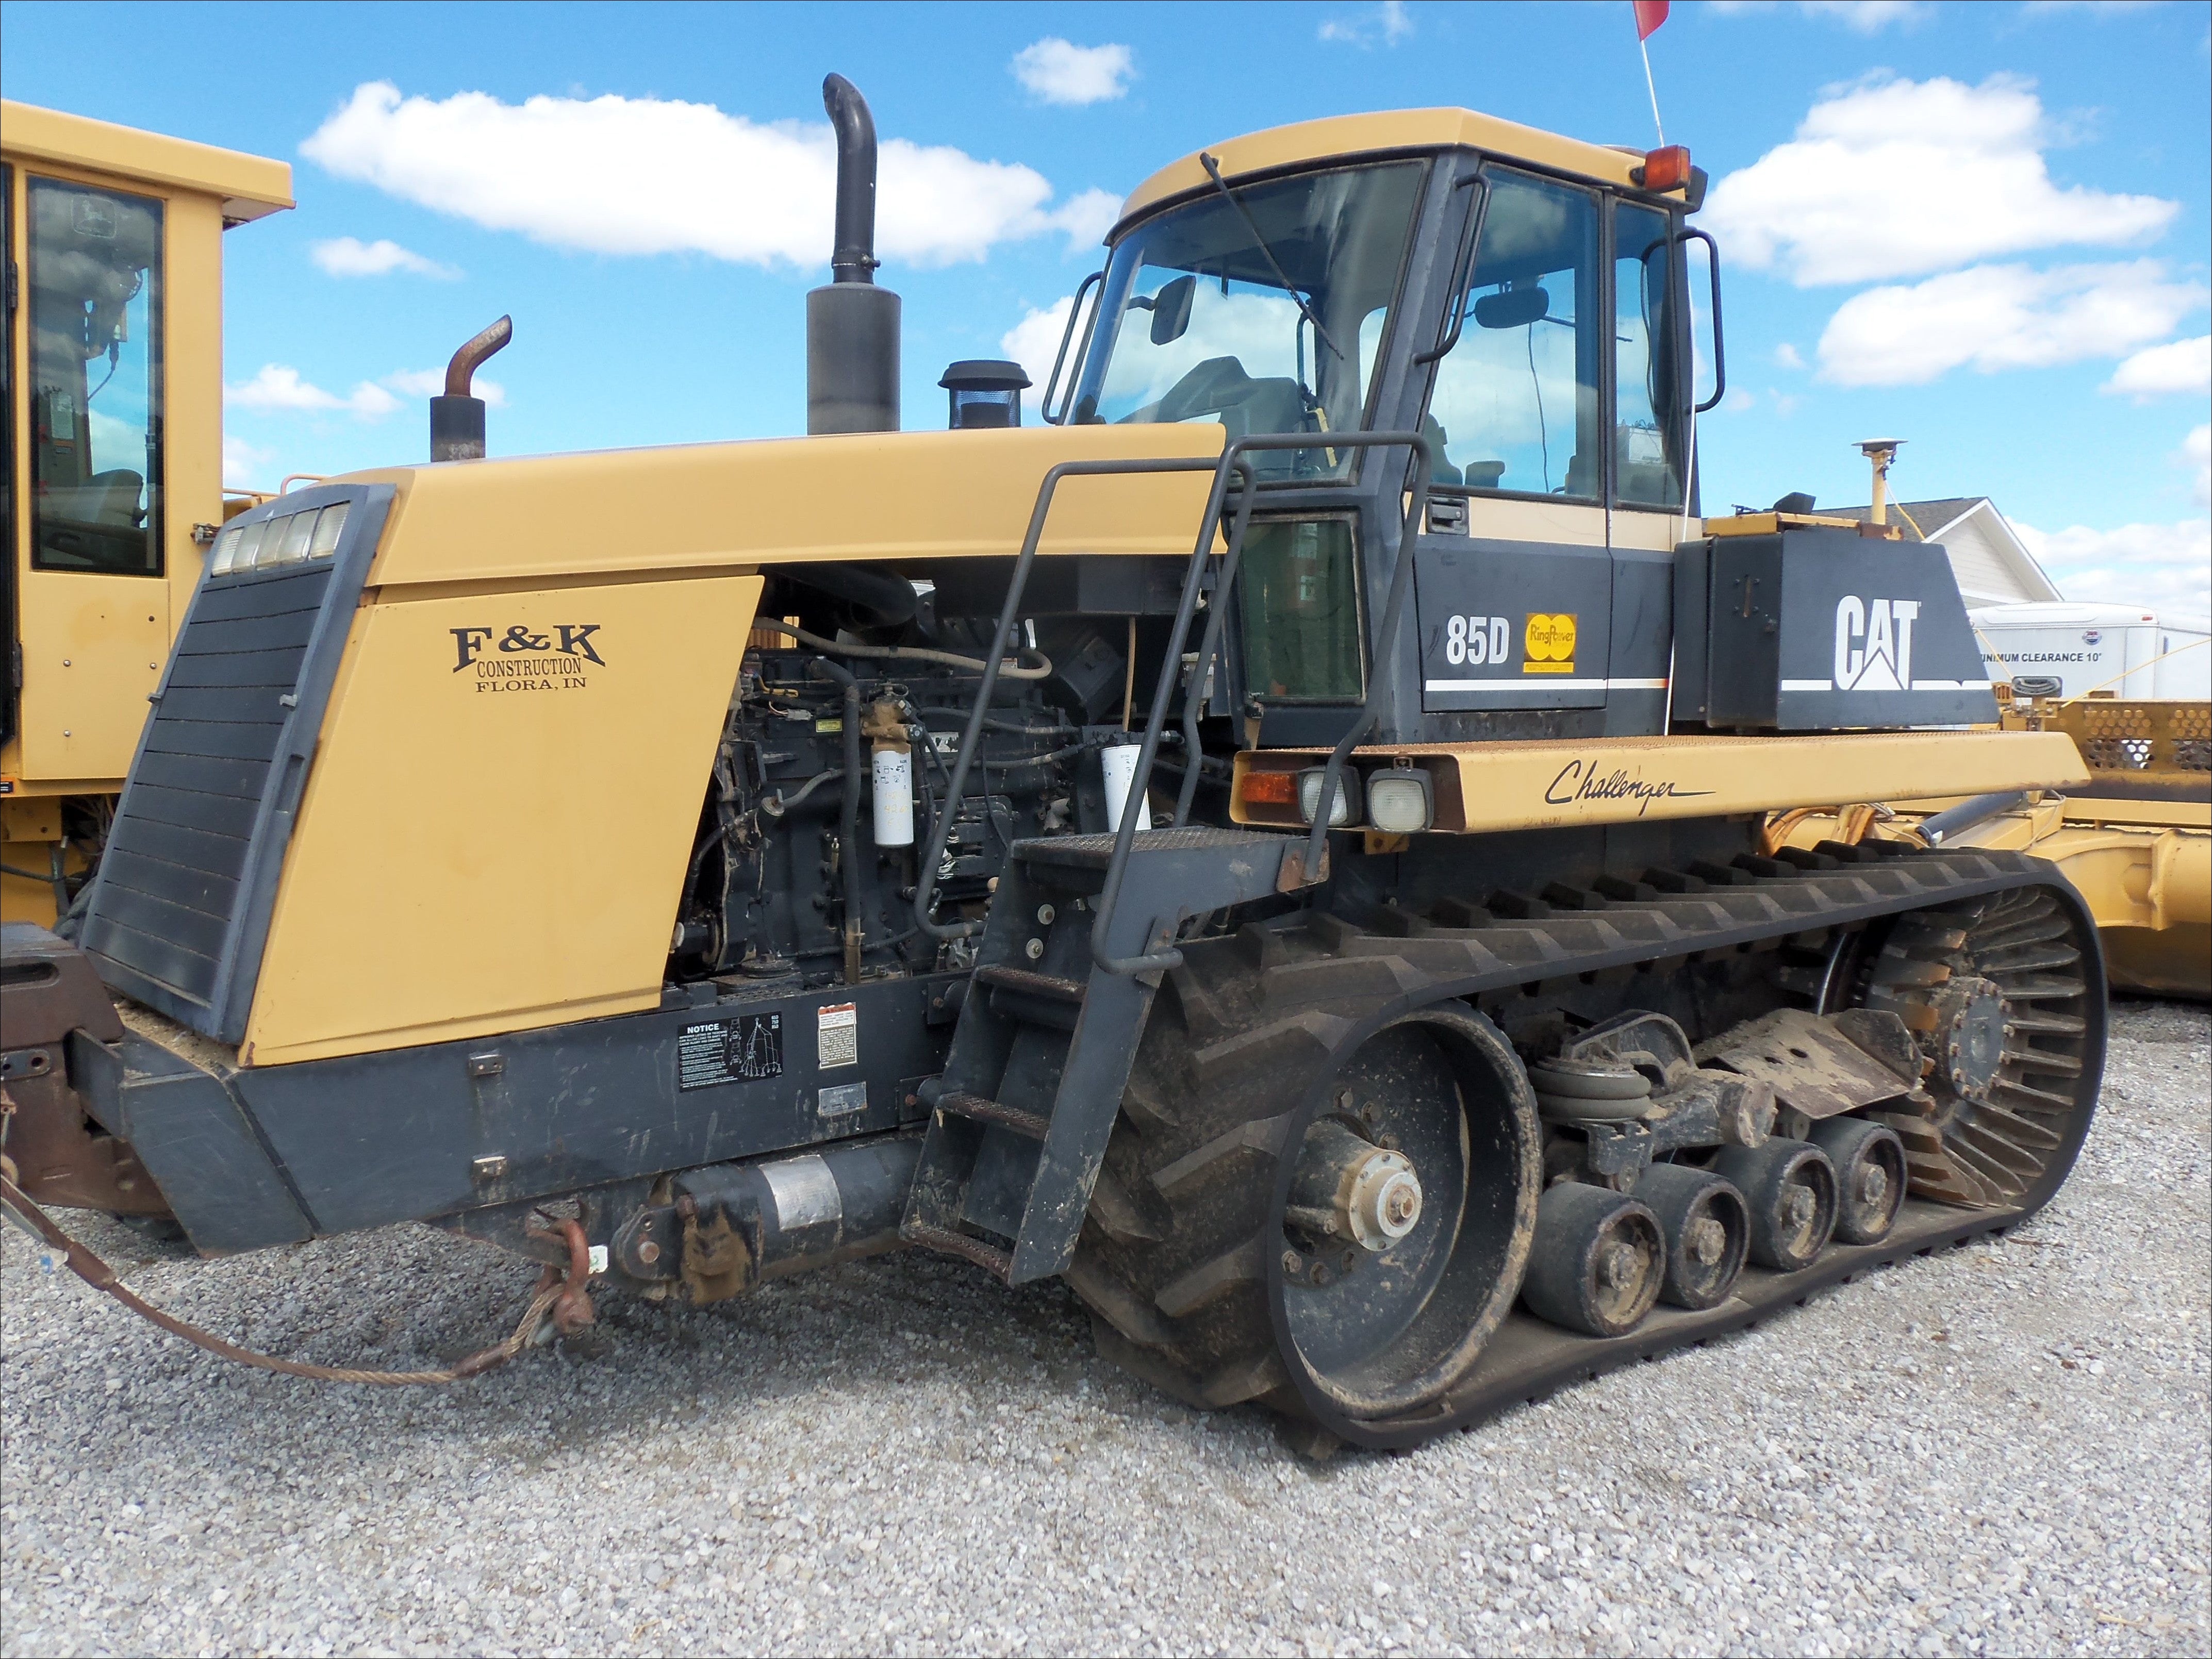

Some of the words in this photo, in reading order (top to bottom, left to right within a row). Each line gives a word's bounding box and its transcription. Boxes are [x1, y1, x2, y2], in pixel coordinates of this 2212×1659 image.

[1446, 615, 1510, 665] 85D
[1835, 595, 1918, 690] CAT
[477, 657, 582, 678] CONSTRUCTION
[1980, 653, 2019, 662] INIMUM
[2021, 653, 2084, 662] CLEARANCE
[475, 678, 558, 692] FLORA,
[563, 677, 587, 688] IN
[1545, 759, 1716, 817] Challenger
[687, 1023, 720, 1034] NOTICE
